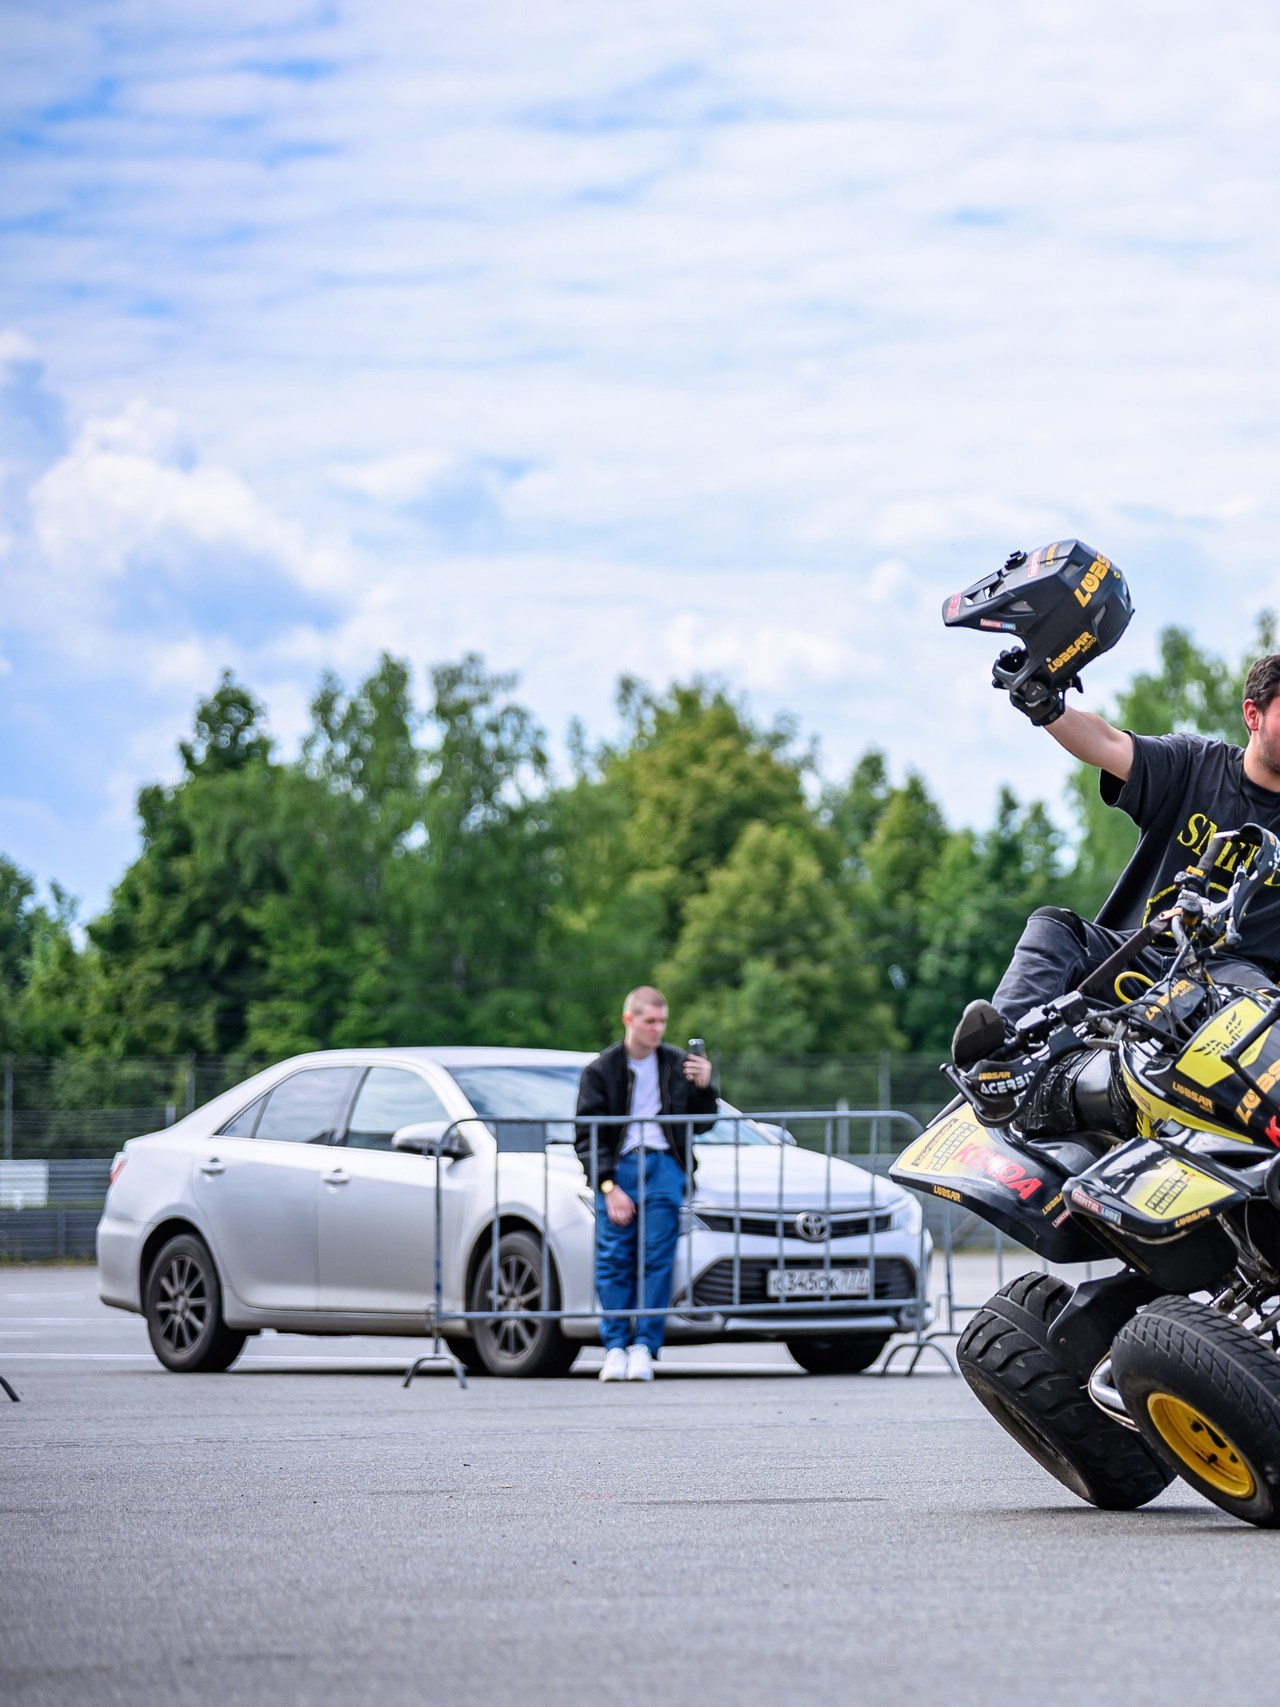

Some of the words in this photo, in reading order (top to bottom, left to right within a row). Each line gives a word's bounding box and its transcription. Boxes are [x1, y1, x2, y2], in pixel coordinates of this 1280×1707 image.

[1047, 631, 1092, 673] LUBSAR
[1082, 637, 1097, 653] MOTO
[979, 1071, 1011, 1080] LUBSAR
[1172, 1081, 1213, 1109] LUBSAR
[951, 1142, 1043, 1200] KENDA
[933, 1184, 960, 1202] LUBSAR
[1175, 1208, 1210, 1228] LUBSAR
